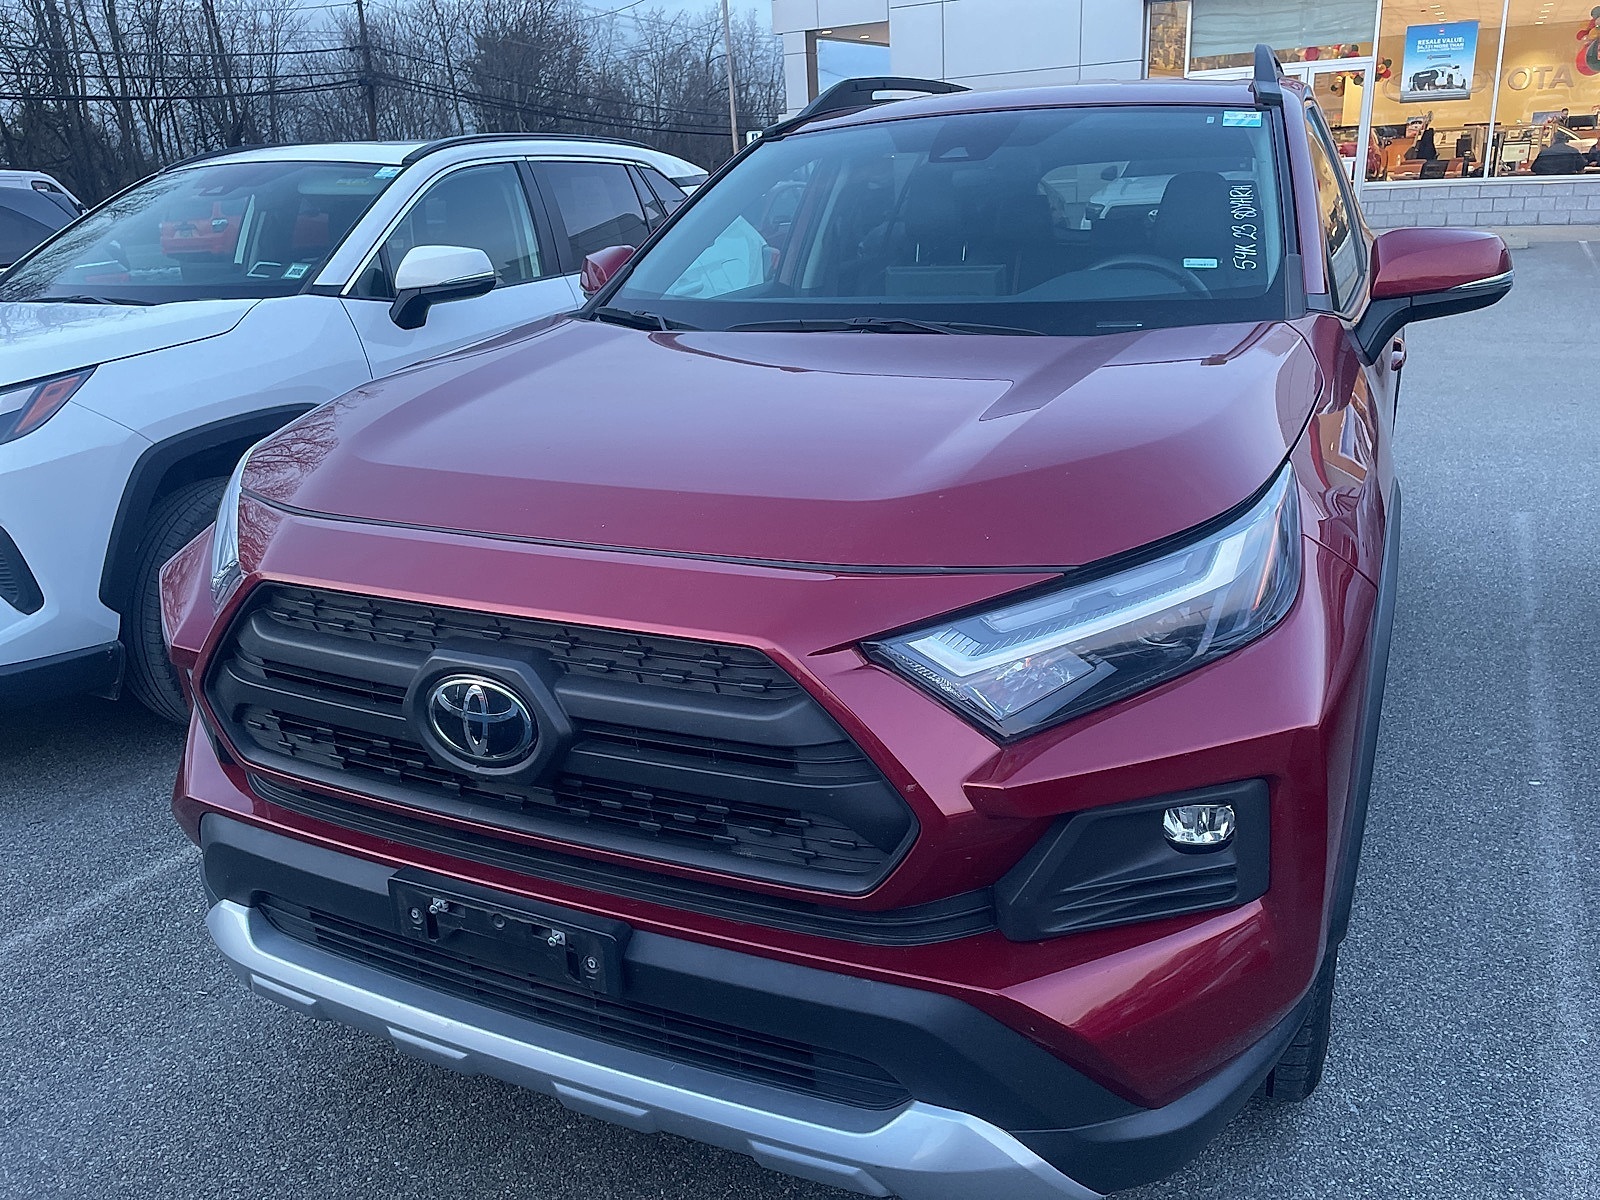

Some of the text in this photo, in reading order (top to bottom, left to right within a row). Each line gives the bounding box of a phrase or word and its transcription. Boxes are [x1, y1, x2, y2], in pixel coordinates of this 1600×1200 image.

[1469, 64, 1575, 93] OYOTA
[1231, 224, 1258, 241] 23
[1232, 243, 1258, 270] 54K
